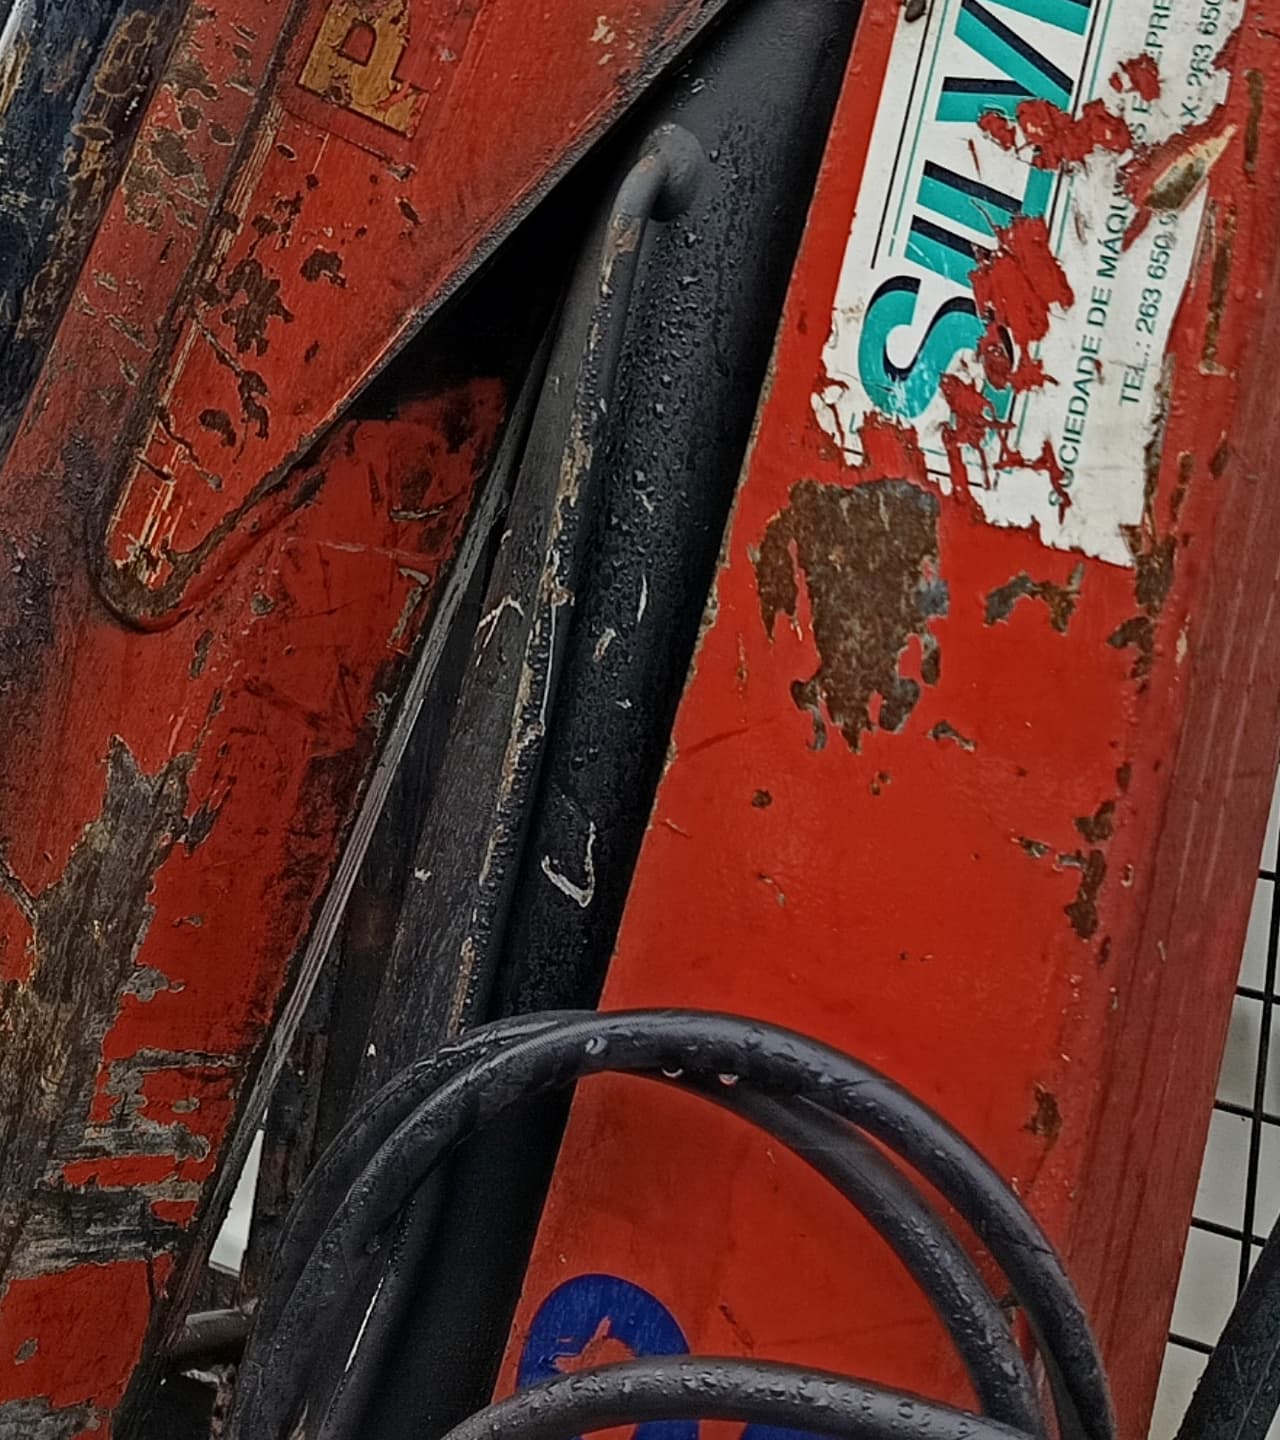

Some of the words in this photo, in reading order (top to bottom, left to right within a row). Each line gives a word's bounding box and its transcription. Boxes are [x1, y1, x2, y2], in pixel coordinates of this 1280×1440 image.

[1146, 233, 1172, 281] 650
[1086, 284, 1113, 329] DE
[1135, 287, 1162, 335] 263
